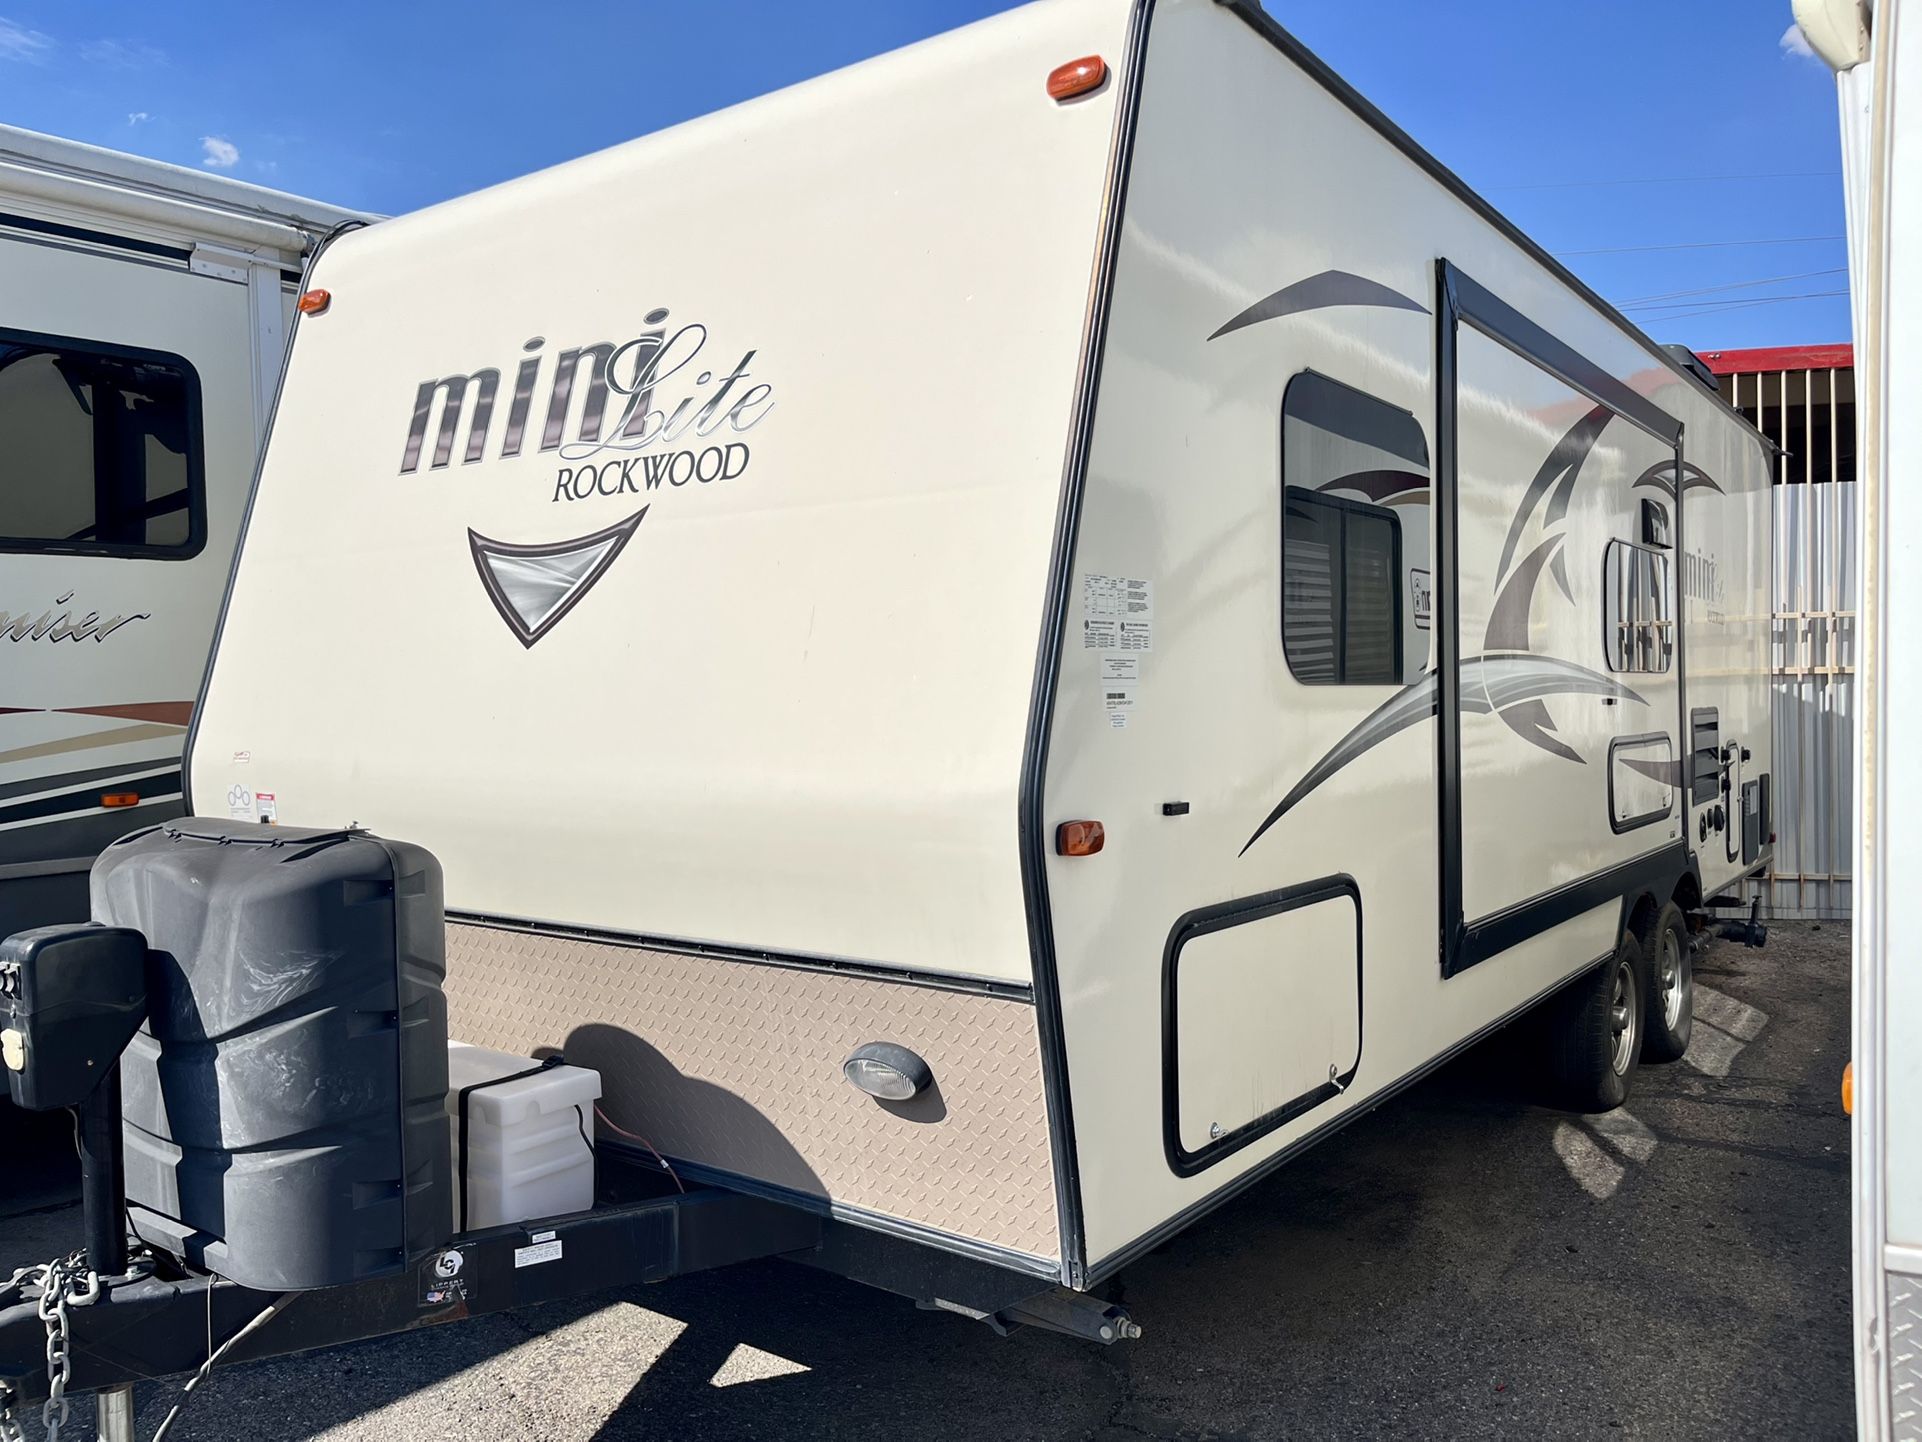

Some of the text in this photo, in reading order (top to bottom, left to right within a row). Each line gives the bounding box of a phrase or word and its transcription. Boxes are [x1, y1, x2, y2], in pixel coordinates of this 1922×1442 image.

[398, 307, 775, 476] mini Lite
[552, 443, 750, 502] ROCKWOOD
